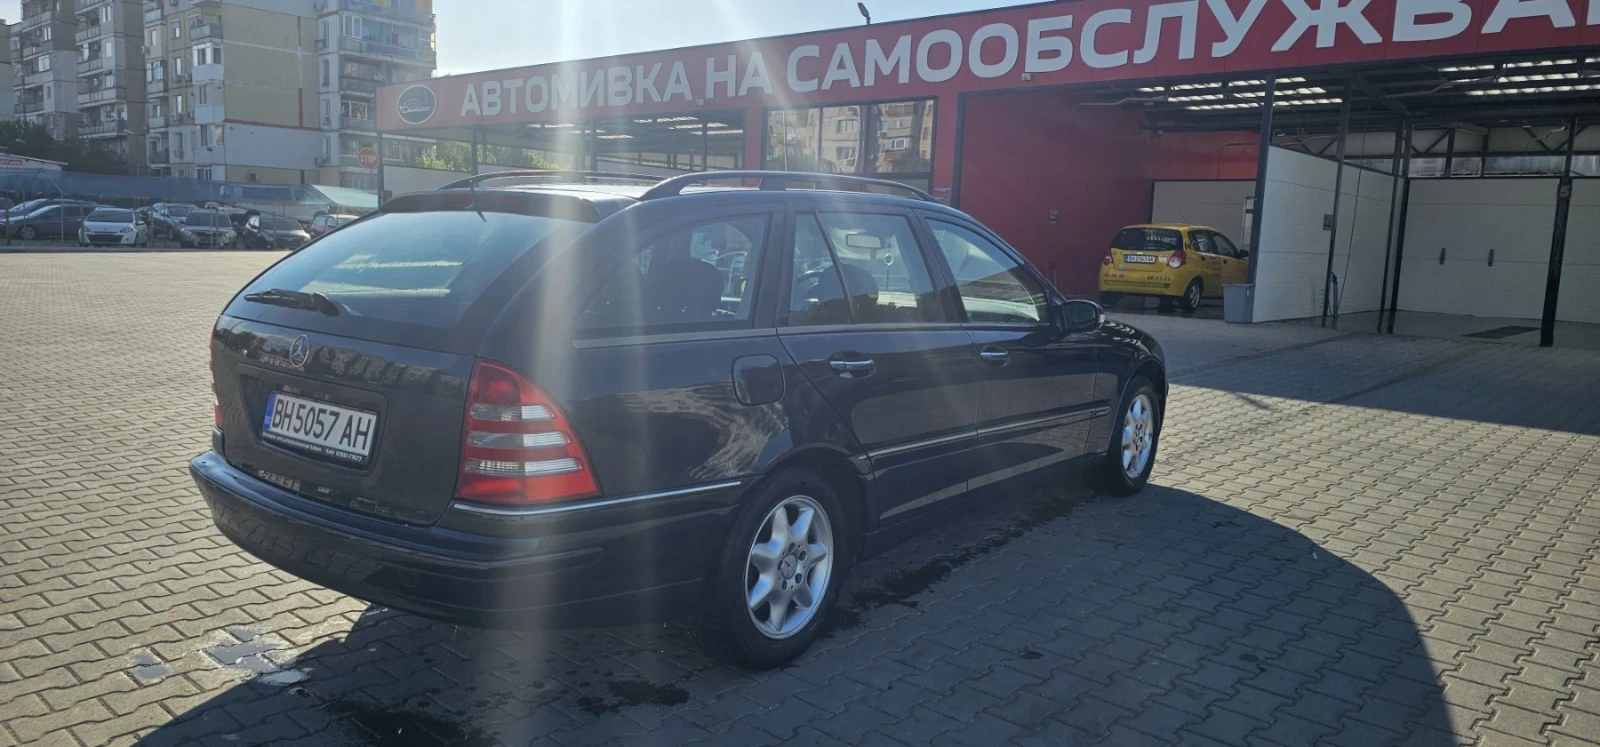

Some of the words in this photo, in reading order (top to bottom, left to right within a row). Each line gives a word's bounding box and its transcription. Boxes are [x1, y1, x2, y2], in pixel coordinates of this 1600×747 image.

[460, 62, 692, 117] АВТОМИВКА
[705, 51, 773, 99] НА
[786, 0, 1600, 93] САМООБСЛУЖВА
[360, 154, 377, 164] STOP
